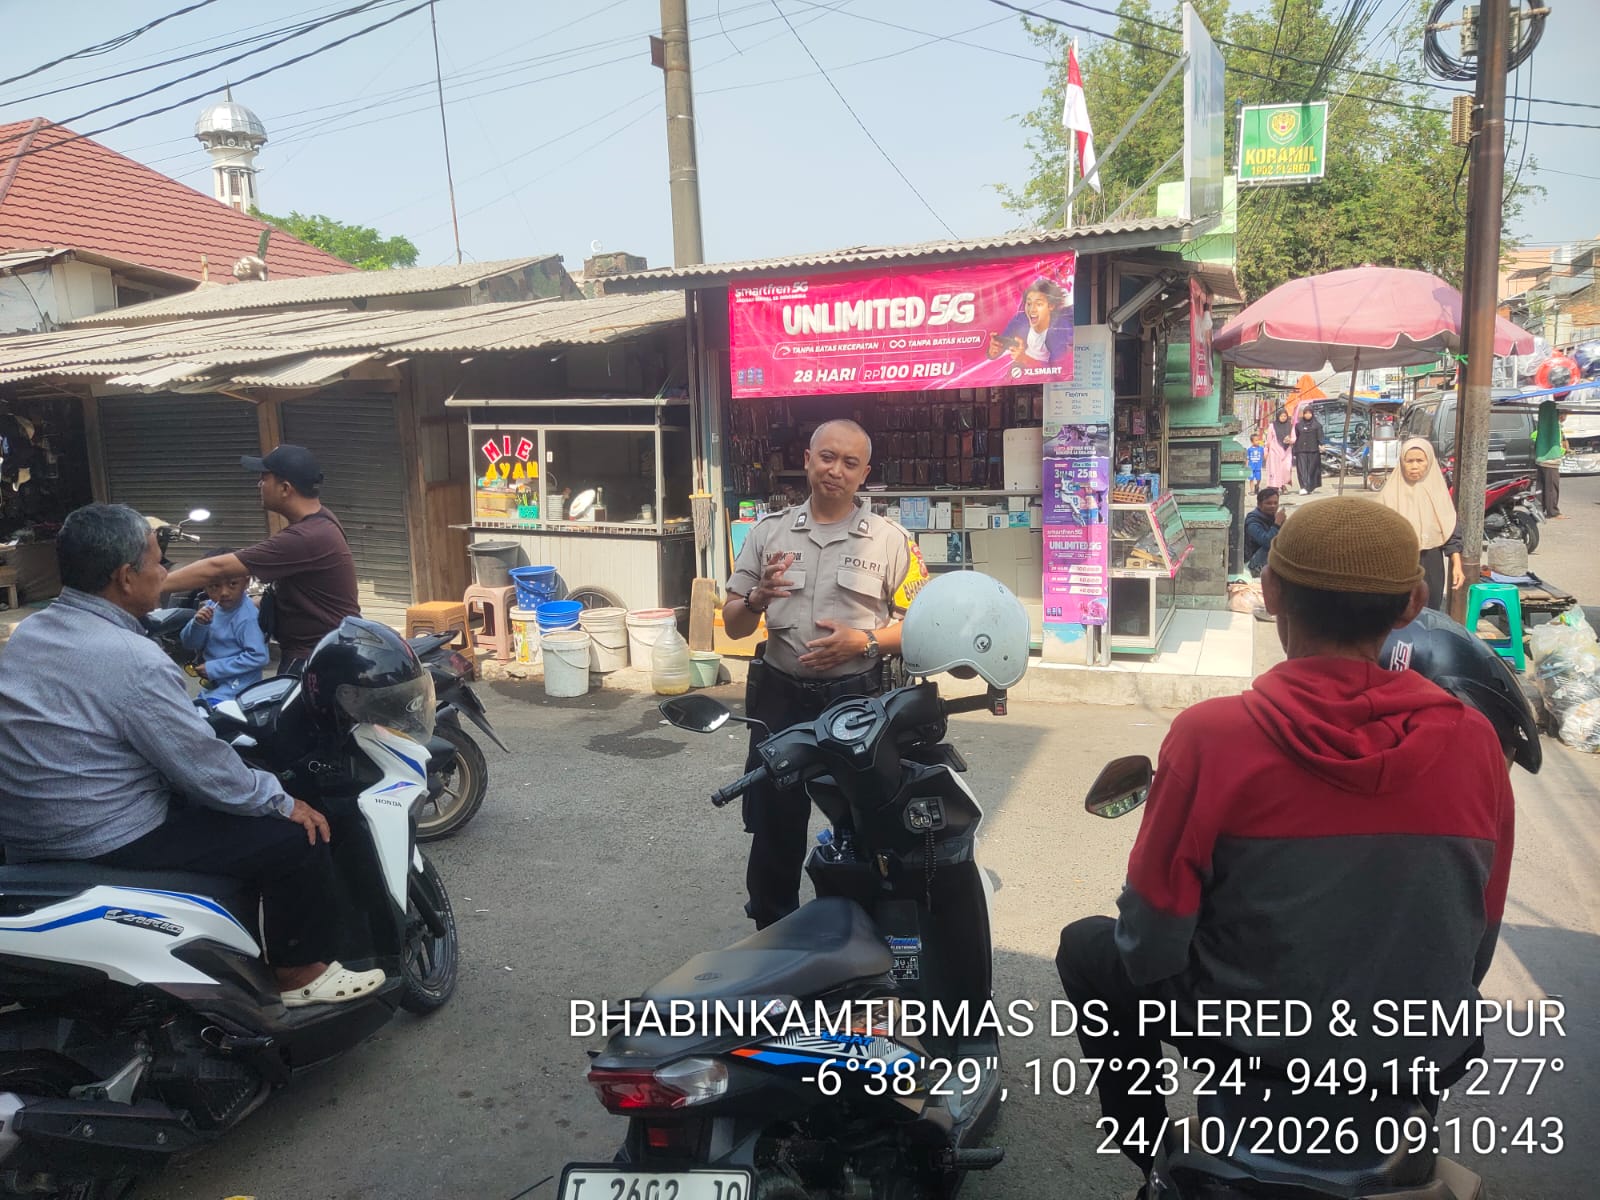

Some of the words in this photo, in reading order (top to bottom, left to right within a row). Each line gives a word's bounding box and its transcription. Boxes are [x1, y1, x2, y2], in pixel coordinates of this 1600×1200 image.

[1245, 146, 1317, 165] KORAMIL
[735, 283, 790, 297] smartfren
[791, 281, 809, 293] 5G
[782, 296, 926, 335] UNLIMITED
[926, 292, 976, 325] 5G
[792, 346, 814, 354] TANPA
[815, 345, 837, 353] BATAS
[837, 342, 879, 351] KECEPATAN
[908, 339, 931, 347] TANPA
[932, 338, 956, 346] BATAS
[956, 336, 981, 344] KUOTA
[793, 369, 813, 383] 28
[815, 367, 857, 382] HARI
[912, 361, 955, 378] RIBU
[1024, 367, 1062, 376] XLSMART
[1049, 541, 1088, 550] UNLIMITED
[844, 556, 881, 573] POLRI
[375, 798, 402, 807] HONDA
